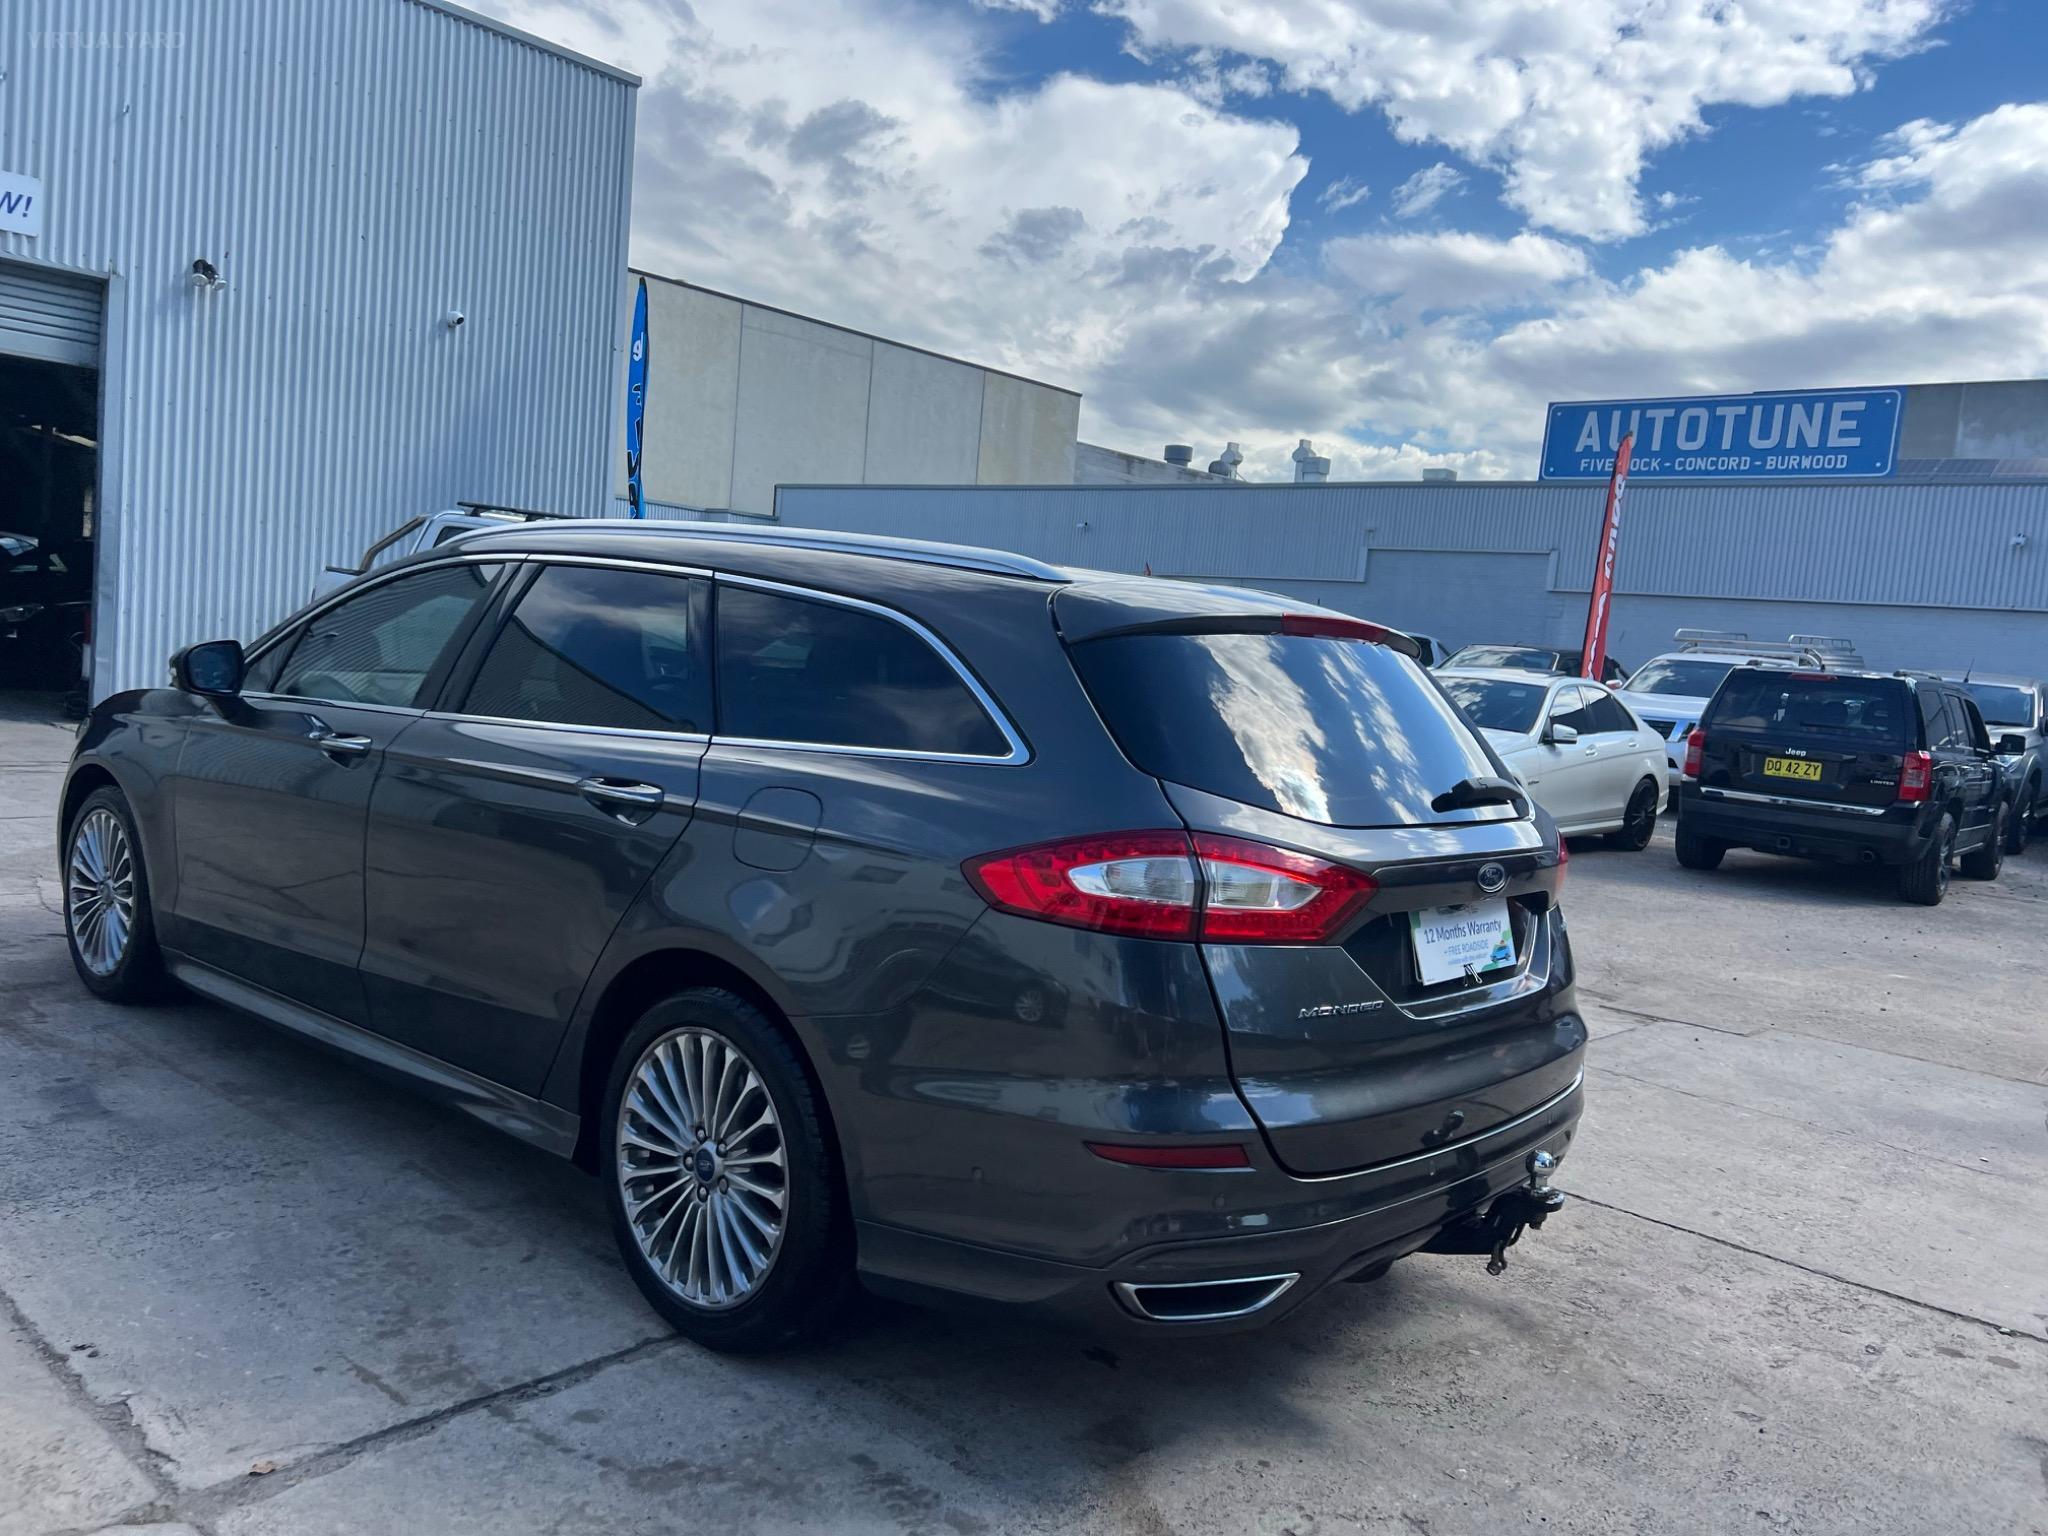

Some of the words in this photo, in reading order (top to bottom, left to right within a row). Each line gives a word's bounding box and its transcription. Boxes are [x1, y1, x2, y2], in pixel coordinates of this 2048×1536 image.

[1575, 401, 1866, 452] AUTOTUNE
[1580, 458, 1614, 471] FIVE
[1628, 457, 1661, 471] OCK
[1675, 456, 1750, 471] CONCORD
[1765, 454, 1848, 470] BURWOOD
[1785, 747, 1807, 757] Jeep
[1424, 928, 1436, 944] 12
[1436, 922, 1467, 941] Months
[1467, 919, 1502, 936] Warranty
[1297, 1000, 1385, 1019] MONDEO
